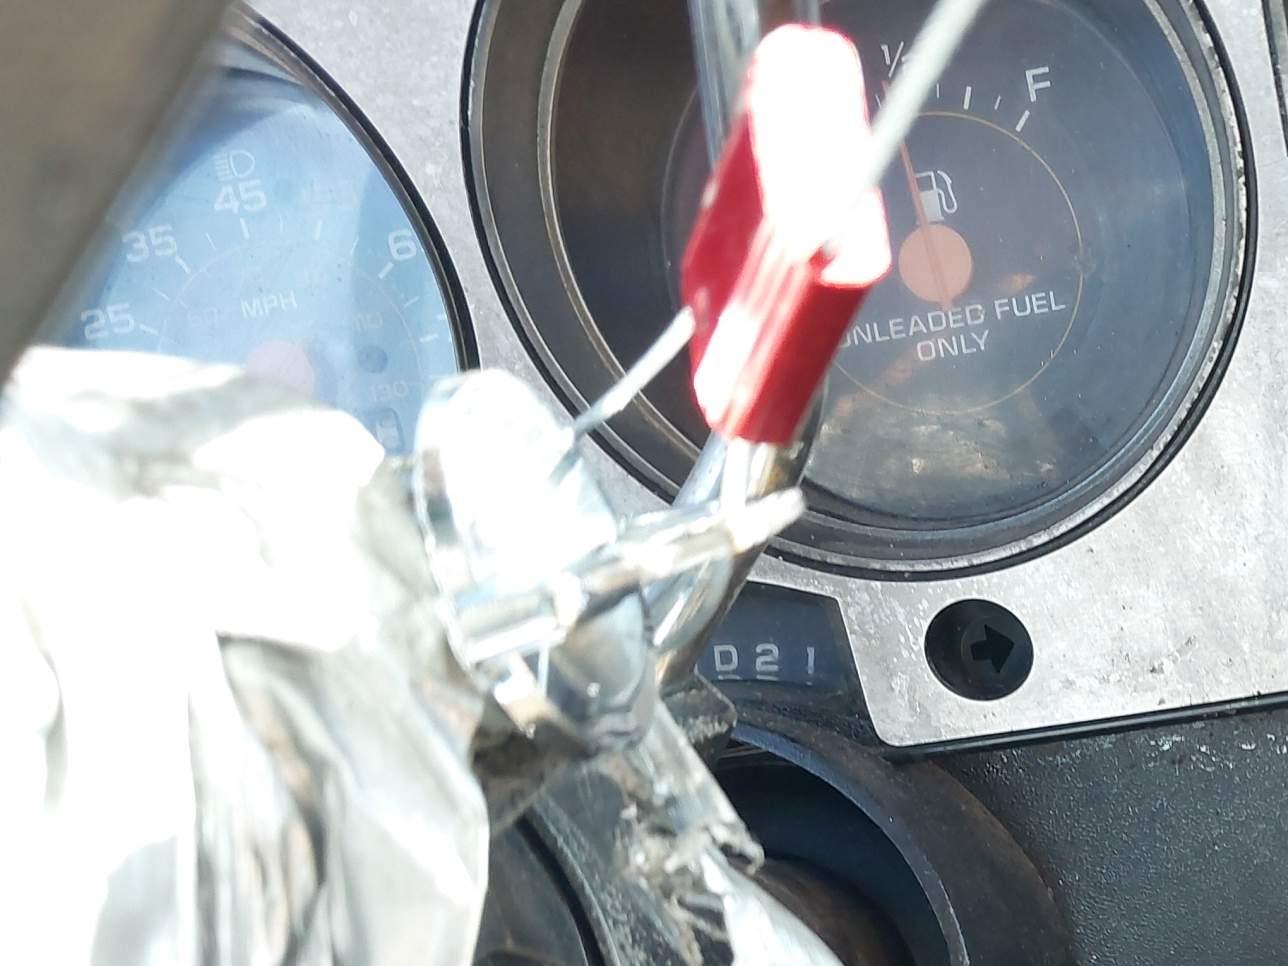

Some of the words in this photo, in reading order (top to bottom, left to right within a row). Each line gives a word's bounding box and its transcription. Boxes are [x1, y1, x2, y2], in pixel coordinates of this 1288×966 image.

[1025, 66, 1050, 102] F
[214, 179, 268, 214] 45
[122, 224, 178, 263] 35
[80, 302, 135, 341] 25
[240, 290, 298, 320] MPH
[994, 290, 1067, 320] FUEL
[916, 329, 989, 361] ONLY
[713, 644, 739, 672] D
[755, 643, 780, 672] 2
